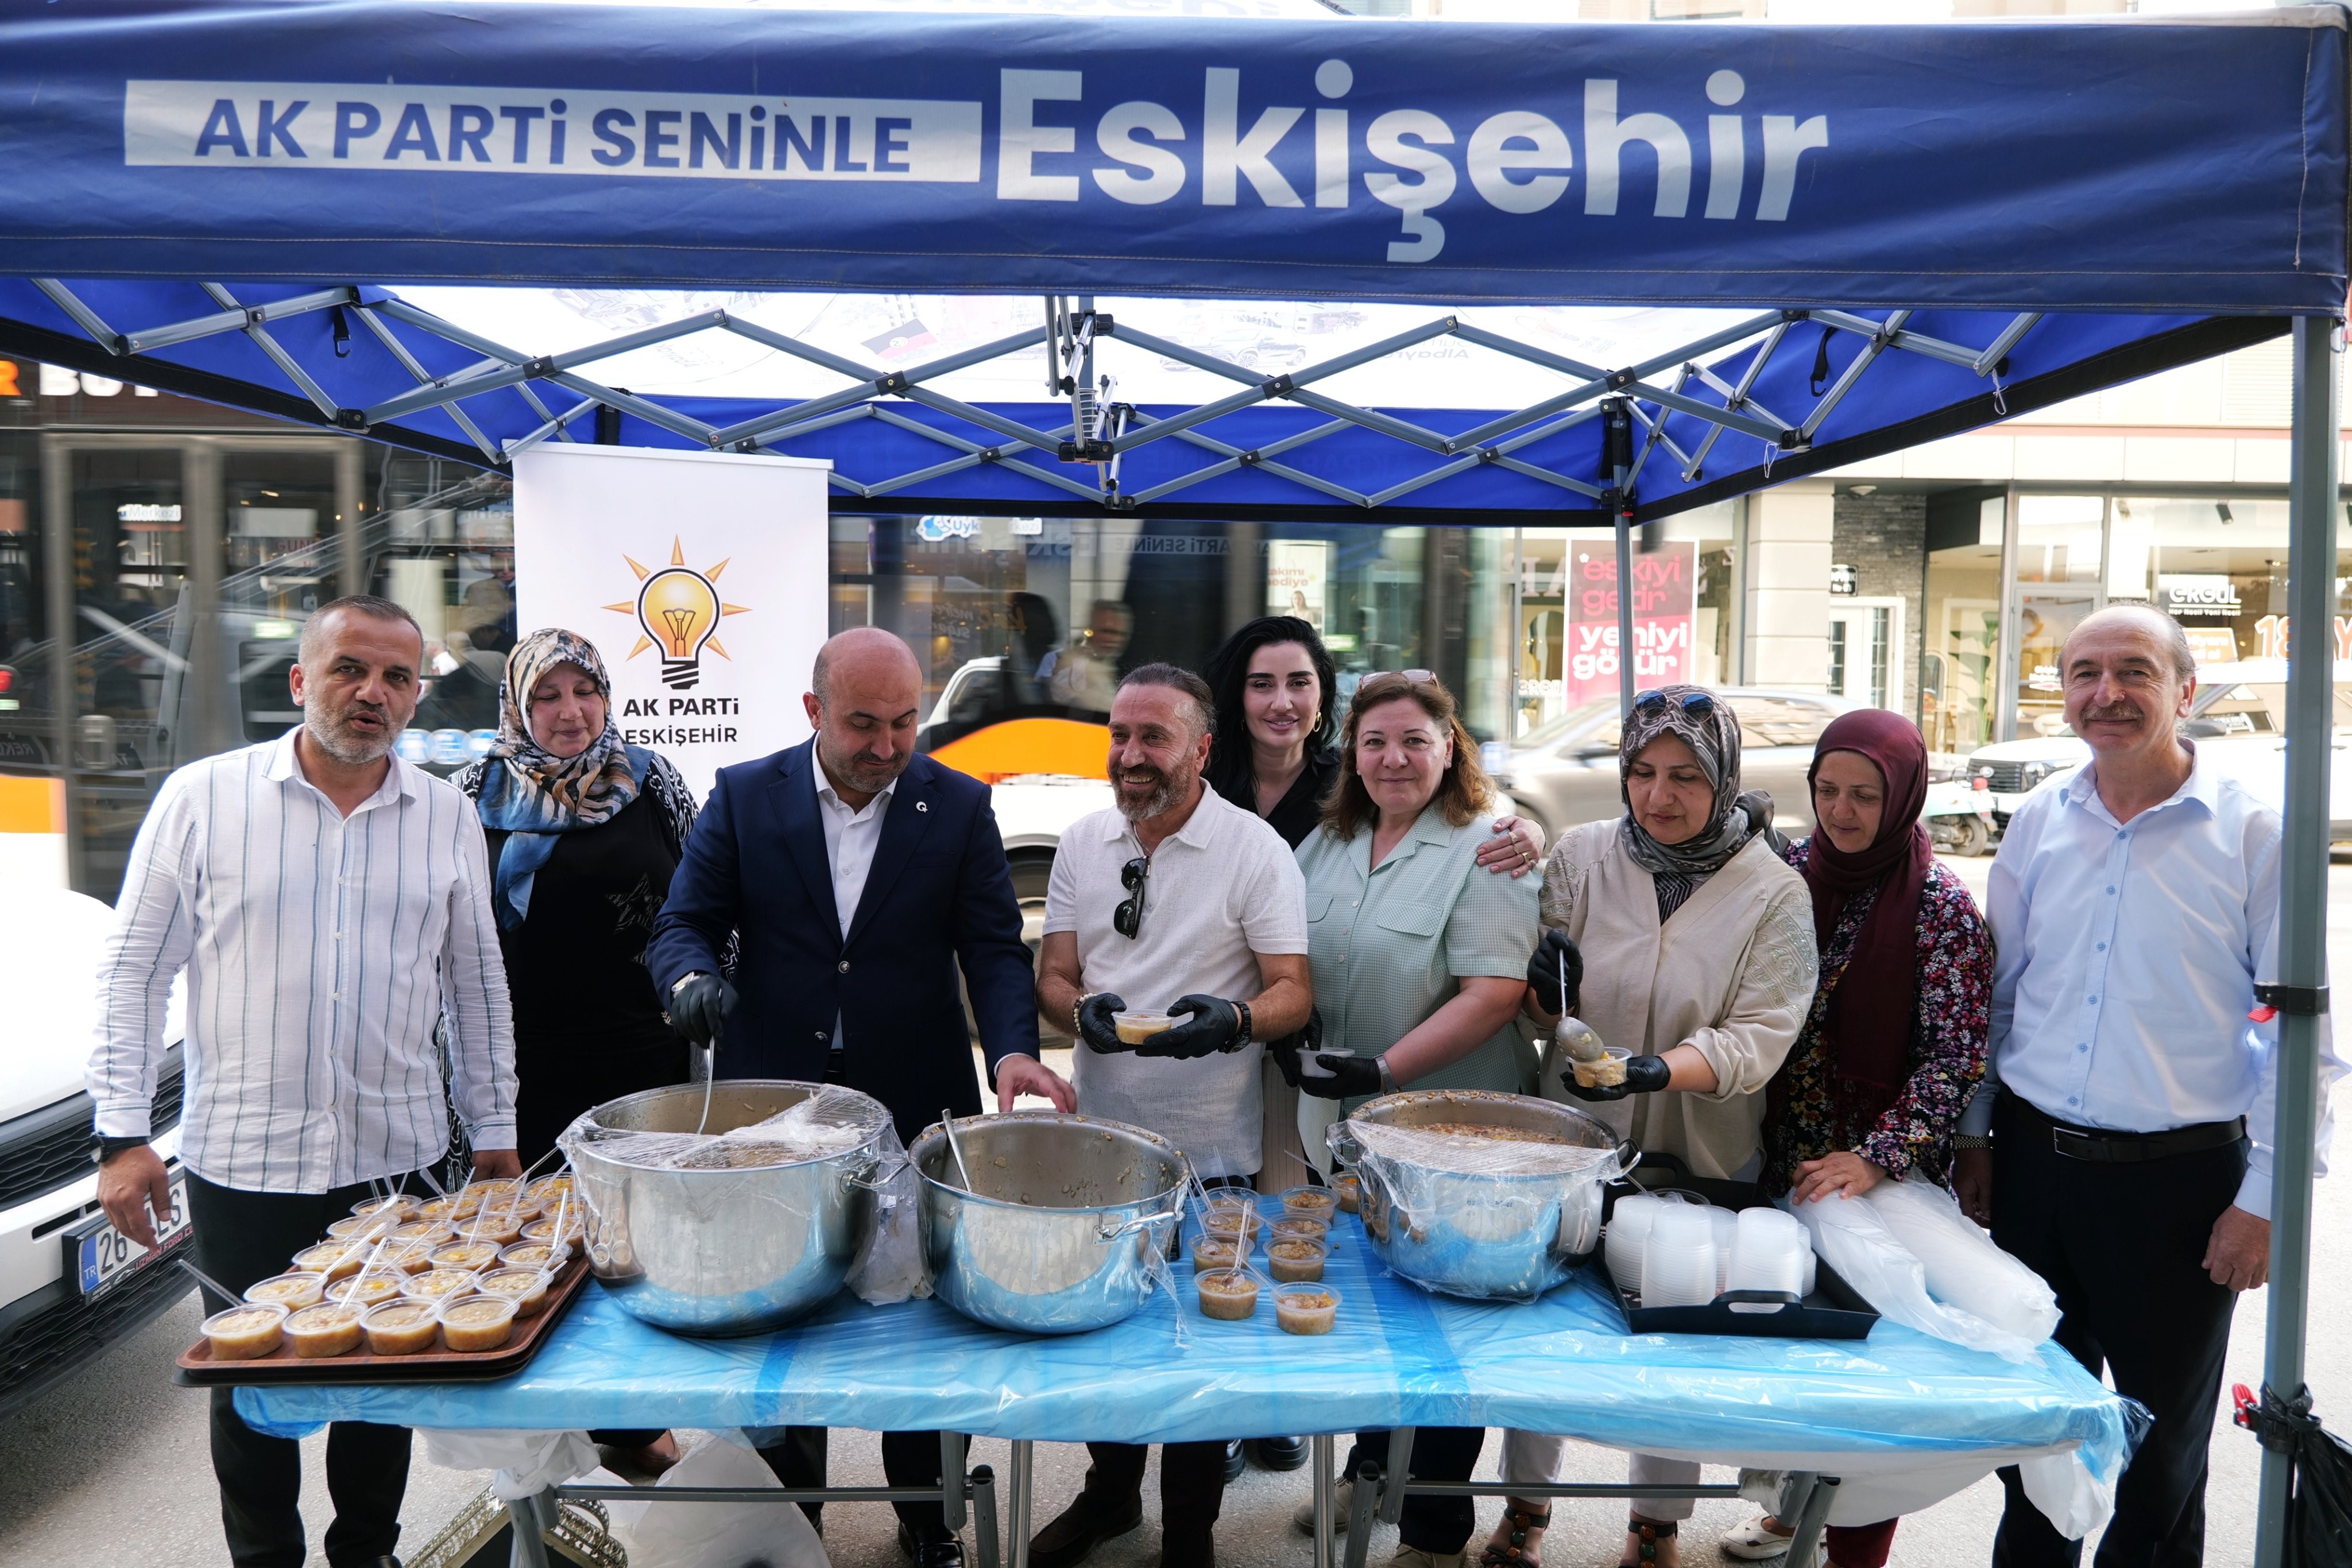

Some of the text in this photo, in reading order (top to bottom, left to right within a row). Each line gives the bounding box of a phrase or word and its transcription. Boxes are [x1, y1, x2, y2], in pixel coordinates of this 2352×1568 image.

[194, 98, 311, 159] AK
[997, 59, 1830, 264] Eskişehir
[953, 518, 980, 533] Uyk
[1572, 648, 1678, 680] göür
[623, 699, 660, 717] AK
[625, 724, 738, 746] ESKİŞEHİR
[99, 1229, 128, 1275] 26
[164, 1232, 183, 1252] FORD
[84, 1264, 97, 1281] TR
